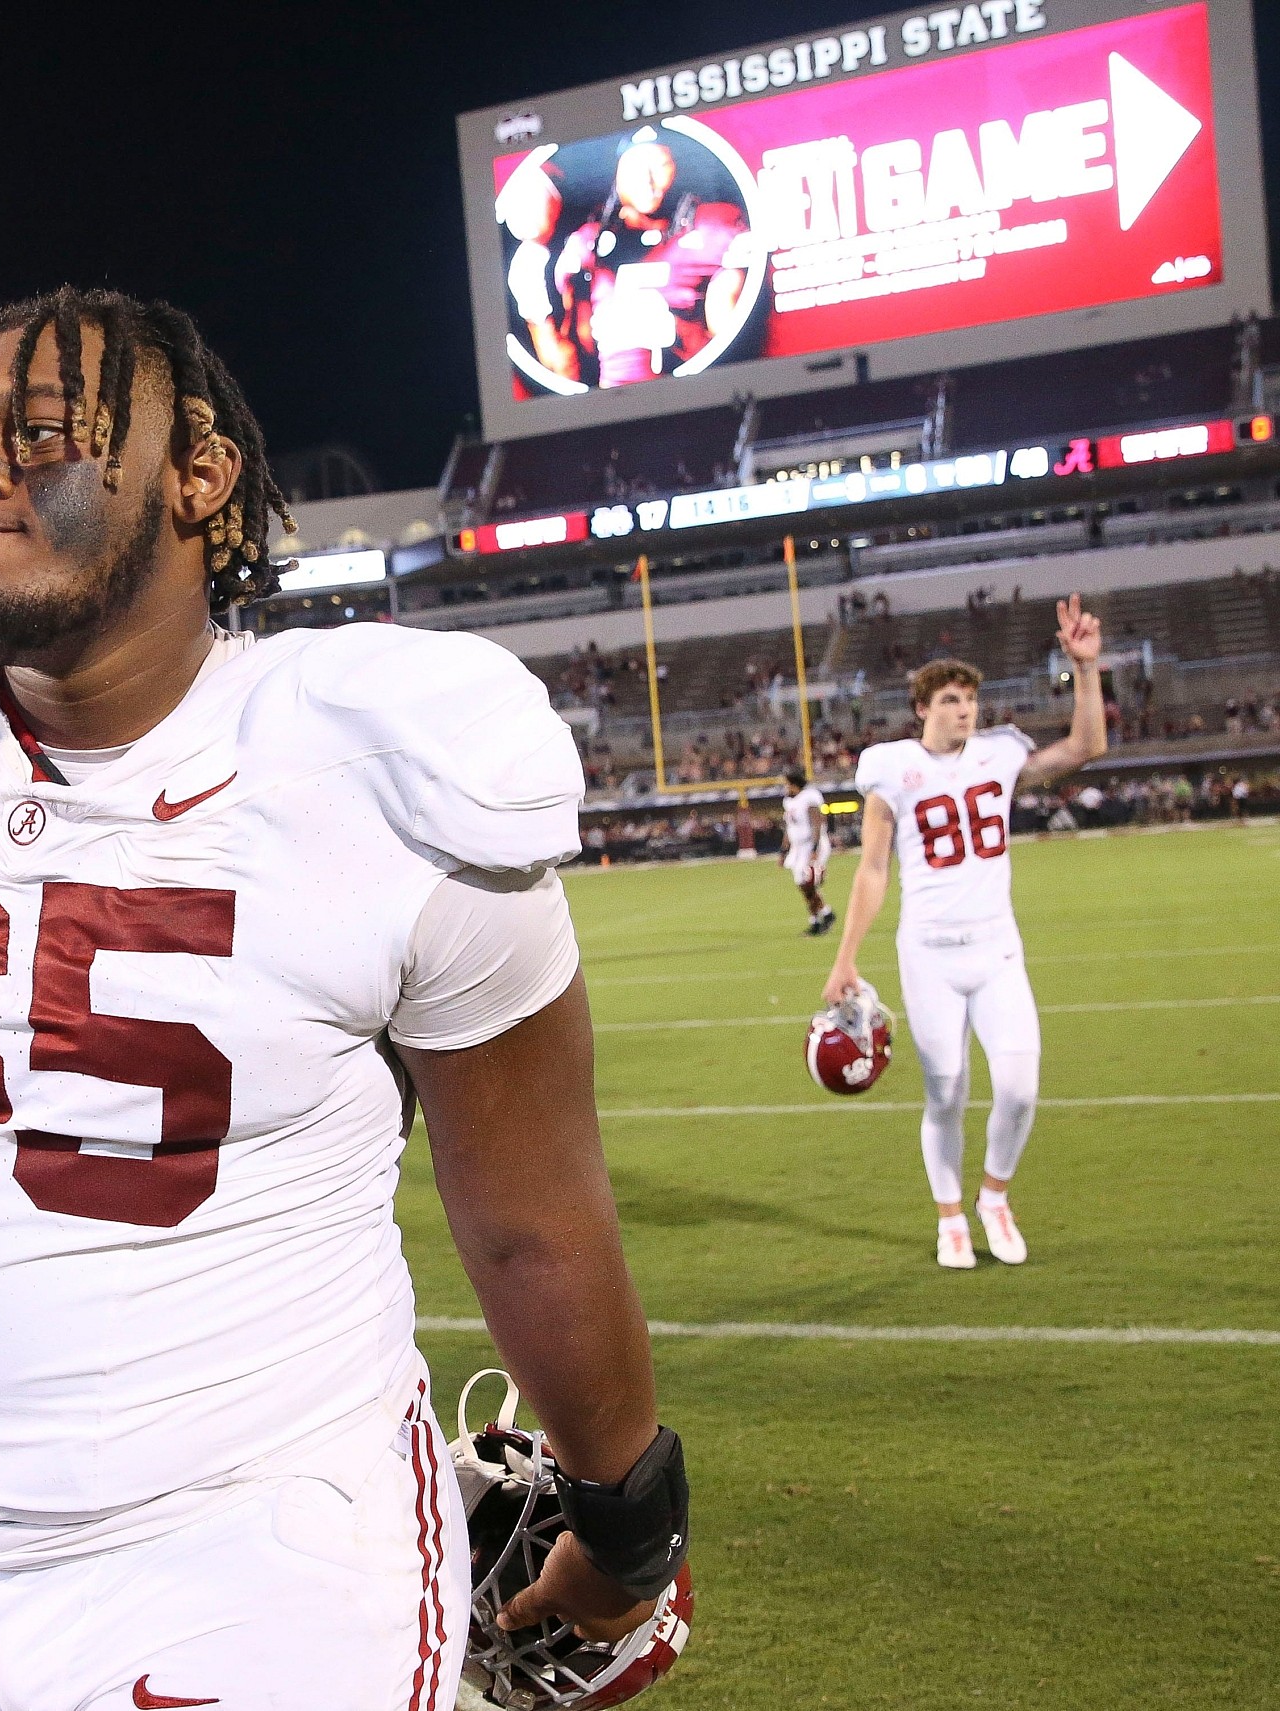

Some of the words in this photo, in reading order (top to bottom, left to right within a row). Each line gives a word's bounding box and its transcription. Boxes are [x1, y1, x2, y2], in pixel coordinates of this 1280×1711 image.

[621, 25, 888, 121] MISSISSIPPI
[902, 0, 1046, 57] STATE
[861, 98, 1115, 233] GAME
[914, 780, 1006, 869] 86
